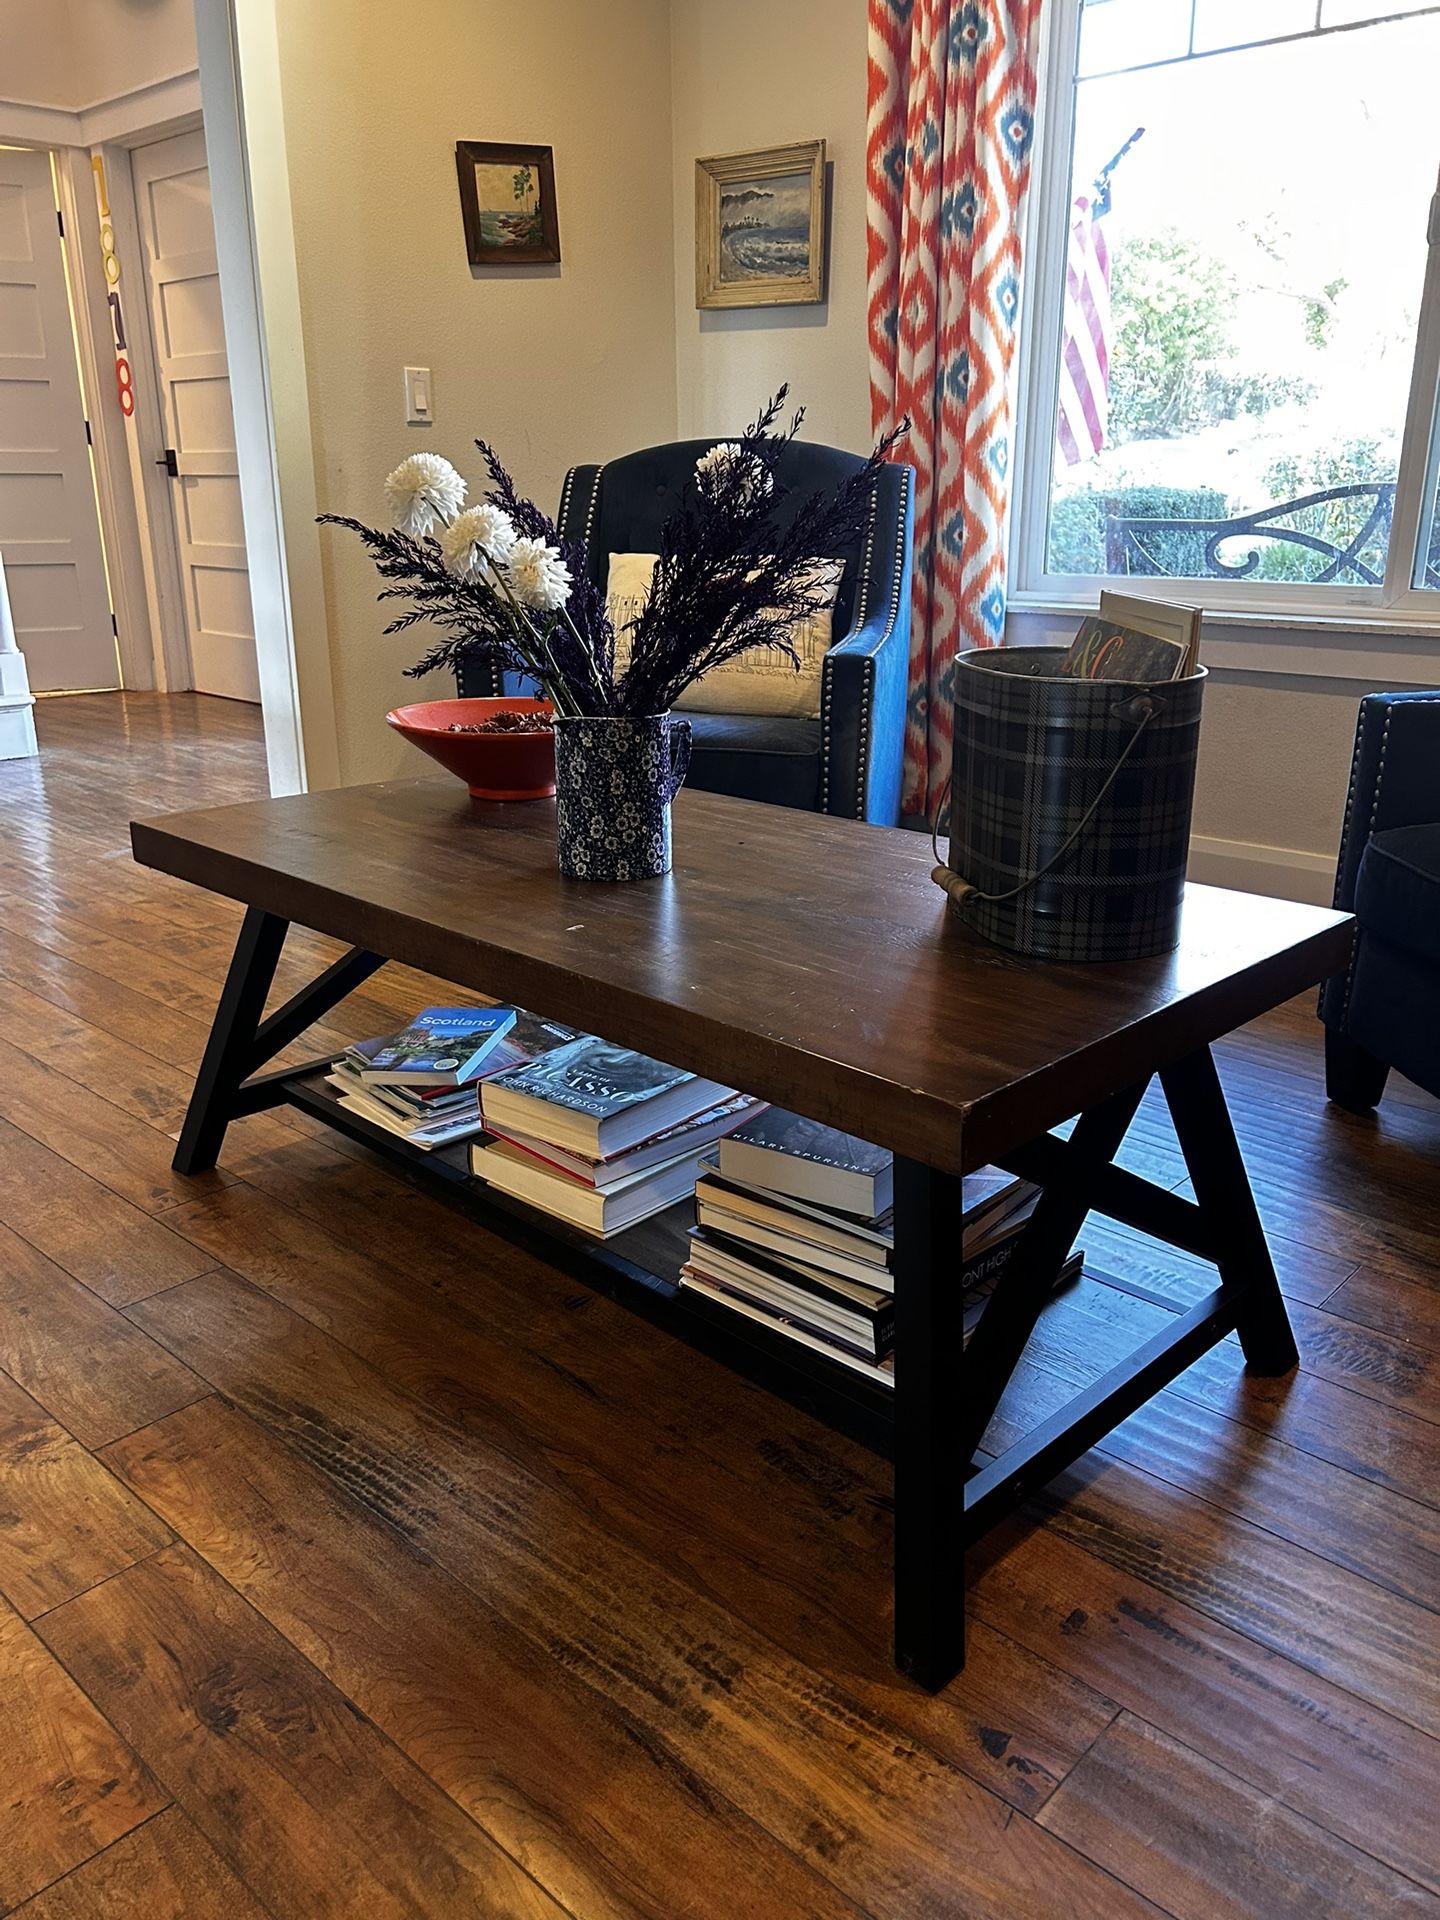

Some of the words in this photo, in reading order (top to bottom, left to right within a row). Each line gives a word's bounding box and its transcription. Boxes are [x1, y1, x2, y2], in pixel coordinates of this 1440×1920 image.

[420, 1016, 496, 1027] Scotland
[496, 1075, 530, 1089] JOHN
[530, 1083, 608, 1113] RICHARDSON
[517, 1061, 634, 1103] PICASSO
[732, 1133, 787, 1151] HILARY
[791, 1149, 871, 1173] SPURLING
[986, 1246, 1012, 1273] HIGH
